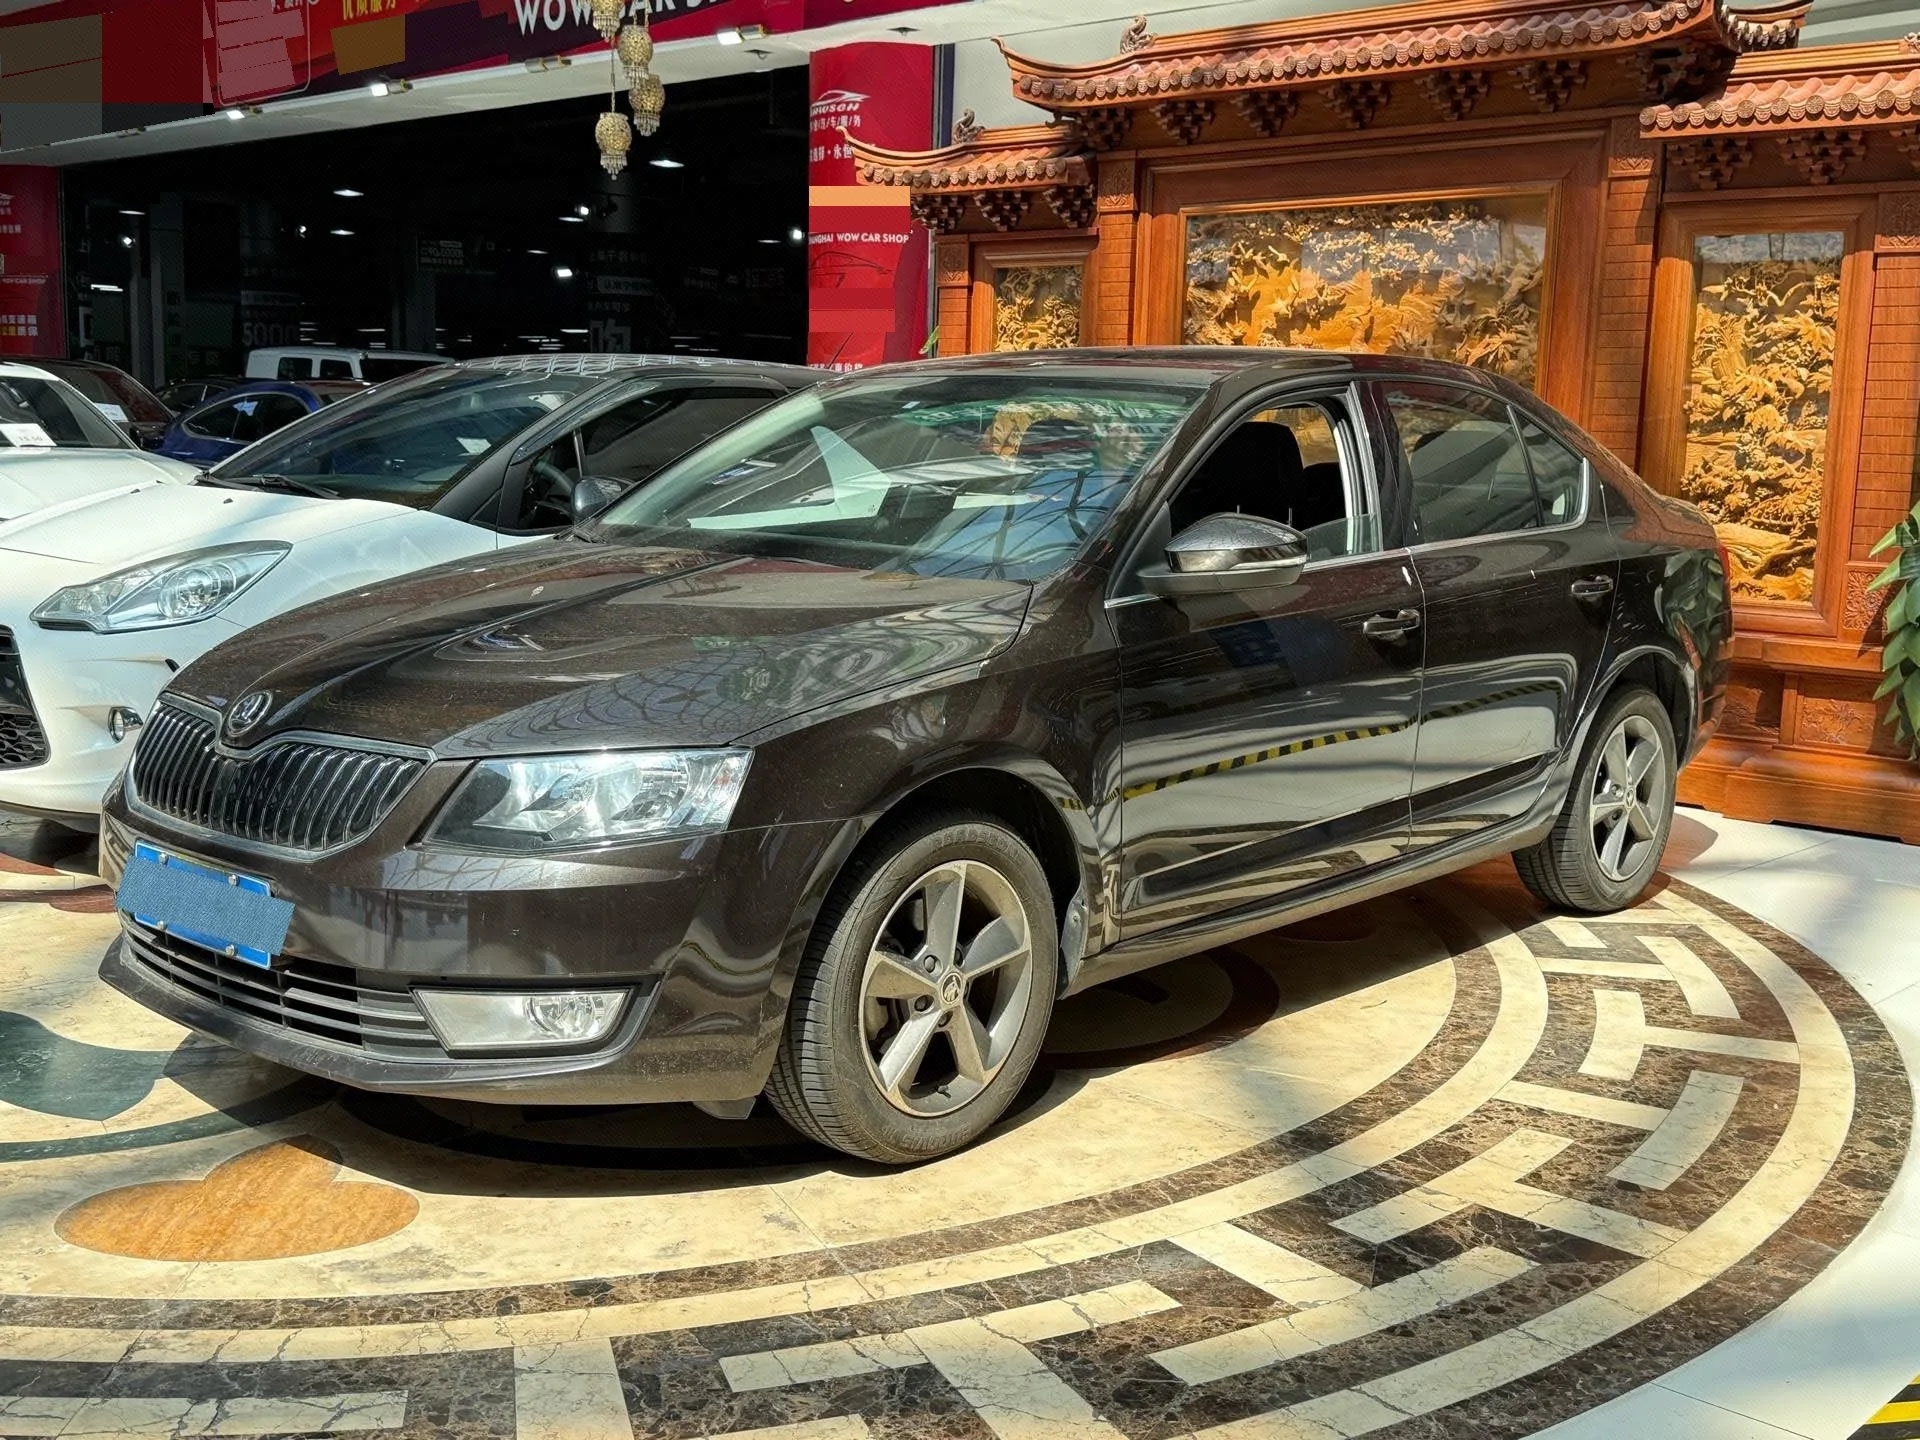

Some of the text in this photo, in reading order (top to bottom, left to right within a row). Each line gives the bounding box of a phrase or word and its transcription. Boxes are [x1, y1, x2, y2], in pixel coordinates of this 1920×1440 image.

[836, 232, 860, 243] WOW
[861, 232, 881, 243] CAR
[882, 233, 910, 244] SHOP
